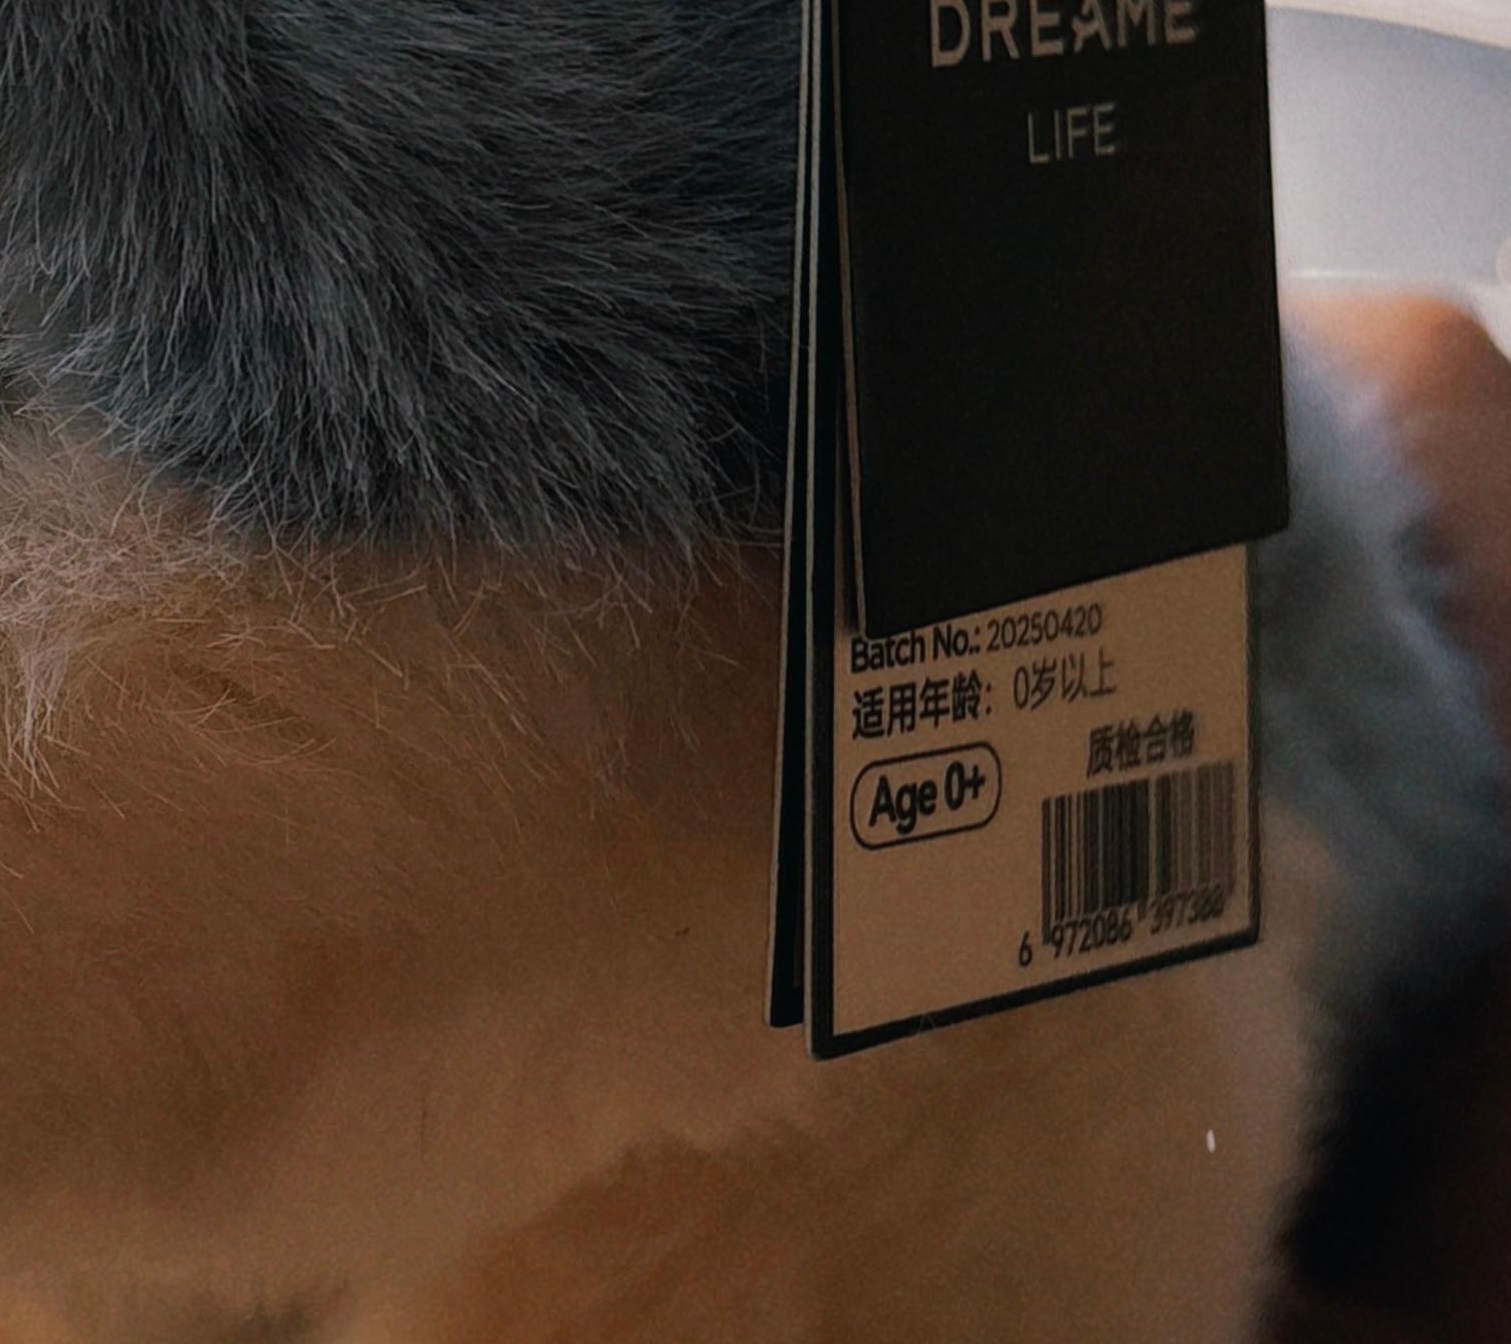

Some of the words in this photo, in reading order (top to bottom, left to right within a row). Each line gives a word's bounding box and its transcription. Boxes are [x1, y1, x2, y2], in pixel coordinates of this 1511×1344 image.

[1026, 102, 1116, 164] LIFE
[850, 632, 926, 674] Batch
[932, 624, 981, 661] No.:
[986, 603, 1103, 653] 20250420
[1086, 710, 1195, 777] 质检合格
[868, 776, 938, 834] Age
[944, 761, 987, 810] 0+
[1018, 930, 1034, 968] 6
